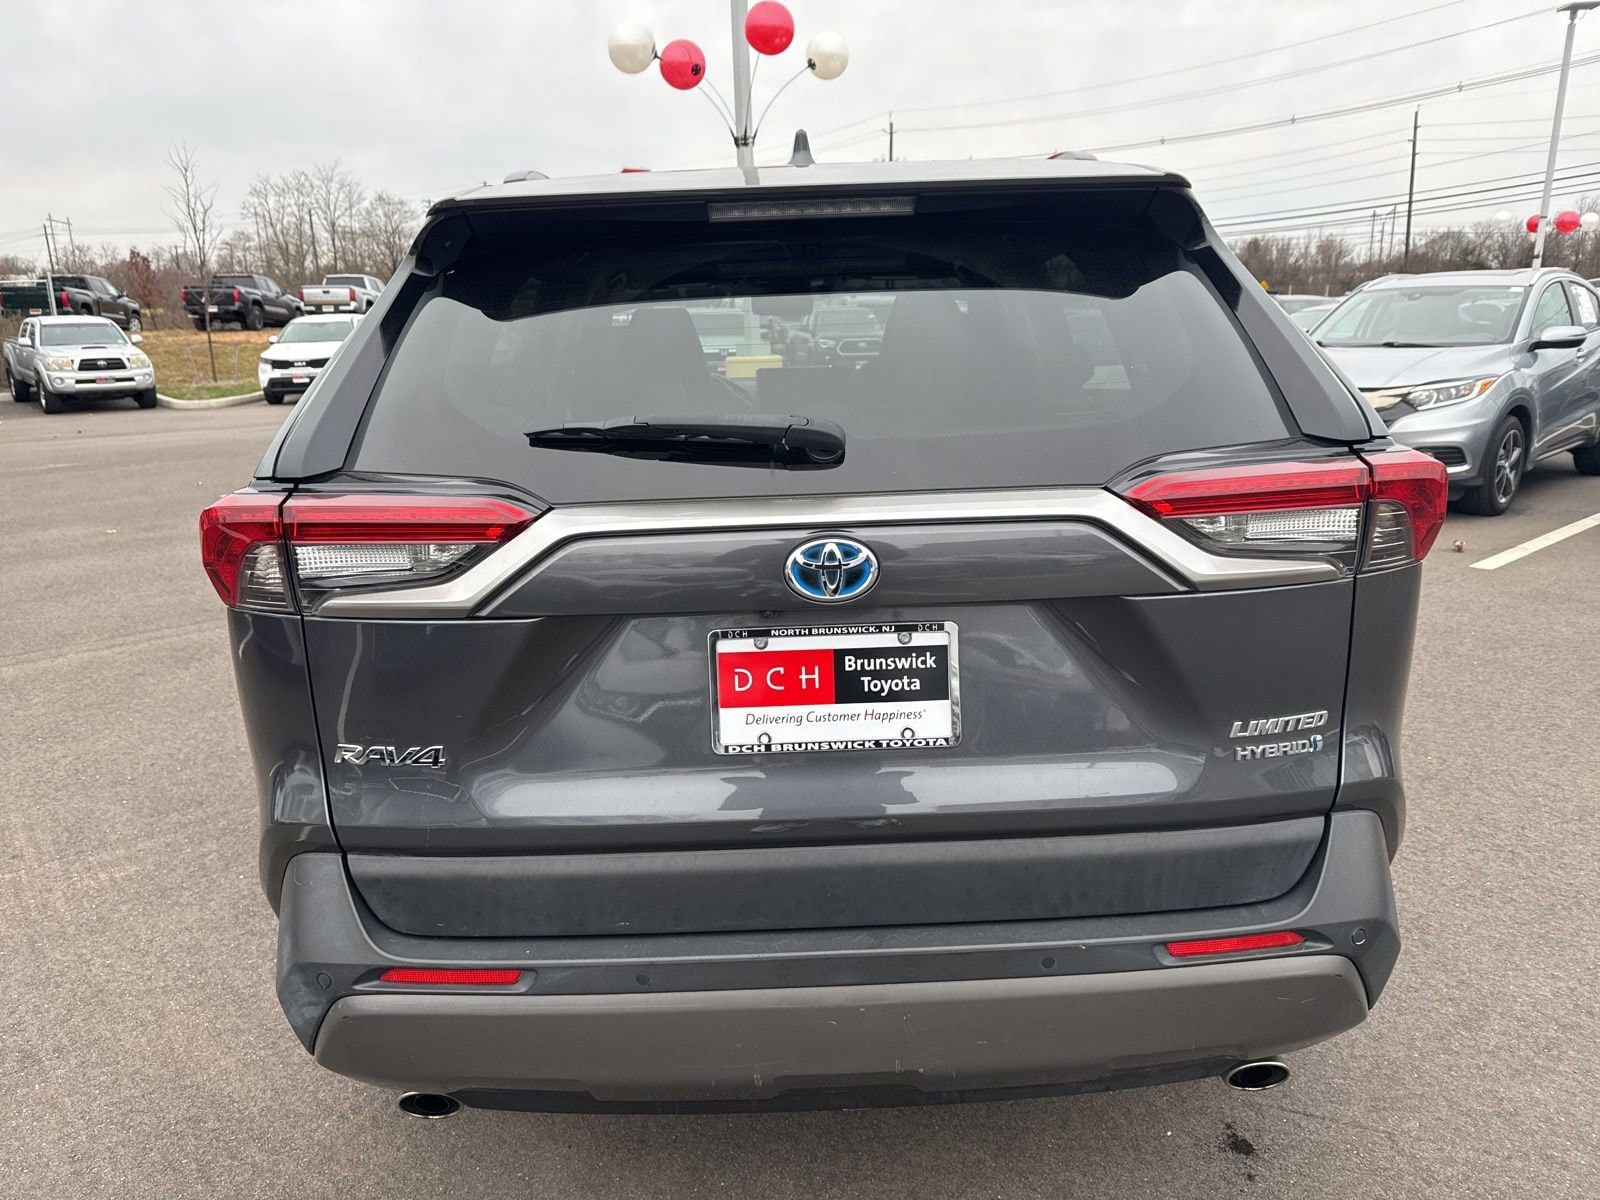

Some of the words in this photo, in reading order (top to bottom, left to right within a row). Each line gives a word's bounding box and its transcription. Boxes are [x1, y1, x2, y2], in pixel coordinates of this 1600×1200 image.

[771, 628, 809, 636] NORTH
[811, 627, 879, 635] BRUNSWICK,
[844, 652, 936, 671] Brunswick
[861, 676, 921, 696] Toyota
[745, 713, 803, 726] Delivering
[806, 711, 860, 724] Customer
[864, 709, 923, 722] Happiness
[1229, 710, 1328, 738] LIMITED
[728, 744, 765, 754] DCH
[771, 739, 876, 751] BRUNSWICK
[879, 737, 947, 747] TOYOTA
[1234, 740, 1310, 761] HYBRID
[334, 744, 447, 768] RAV4
